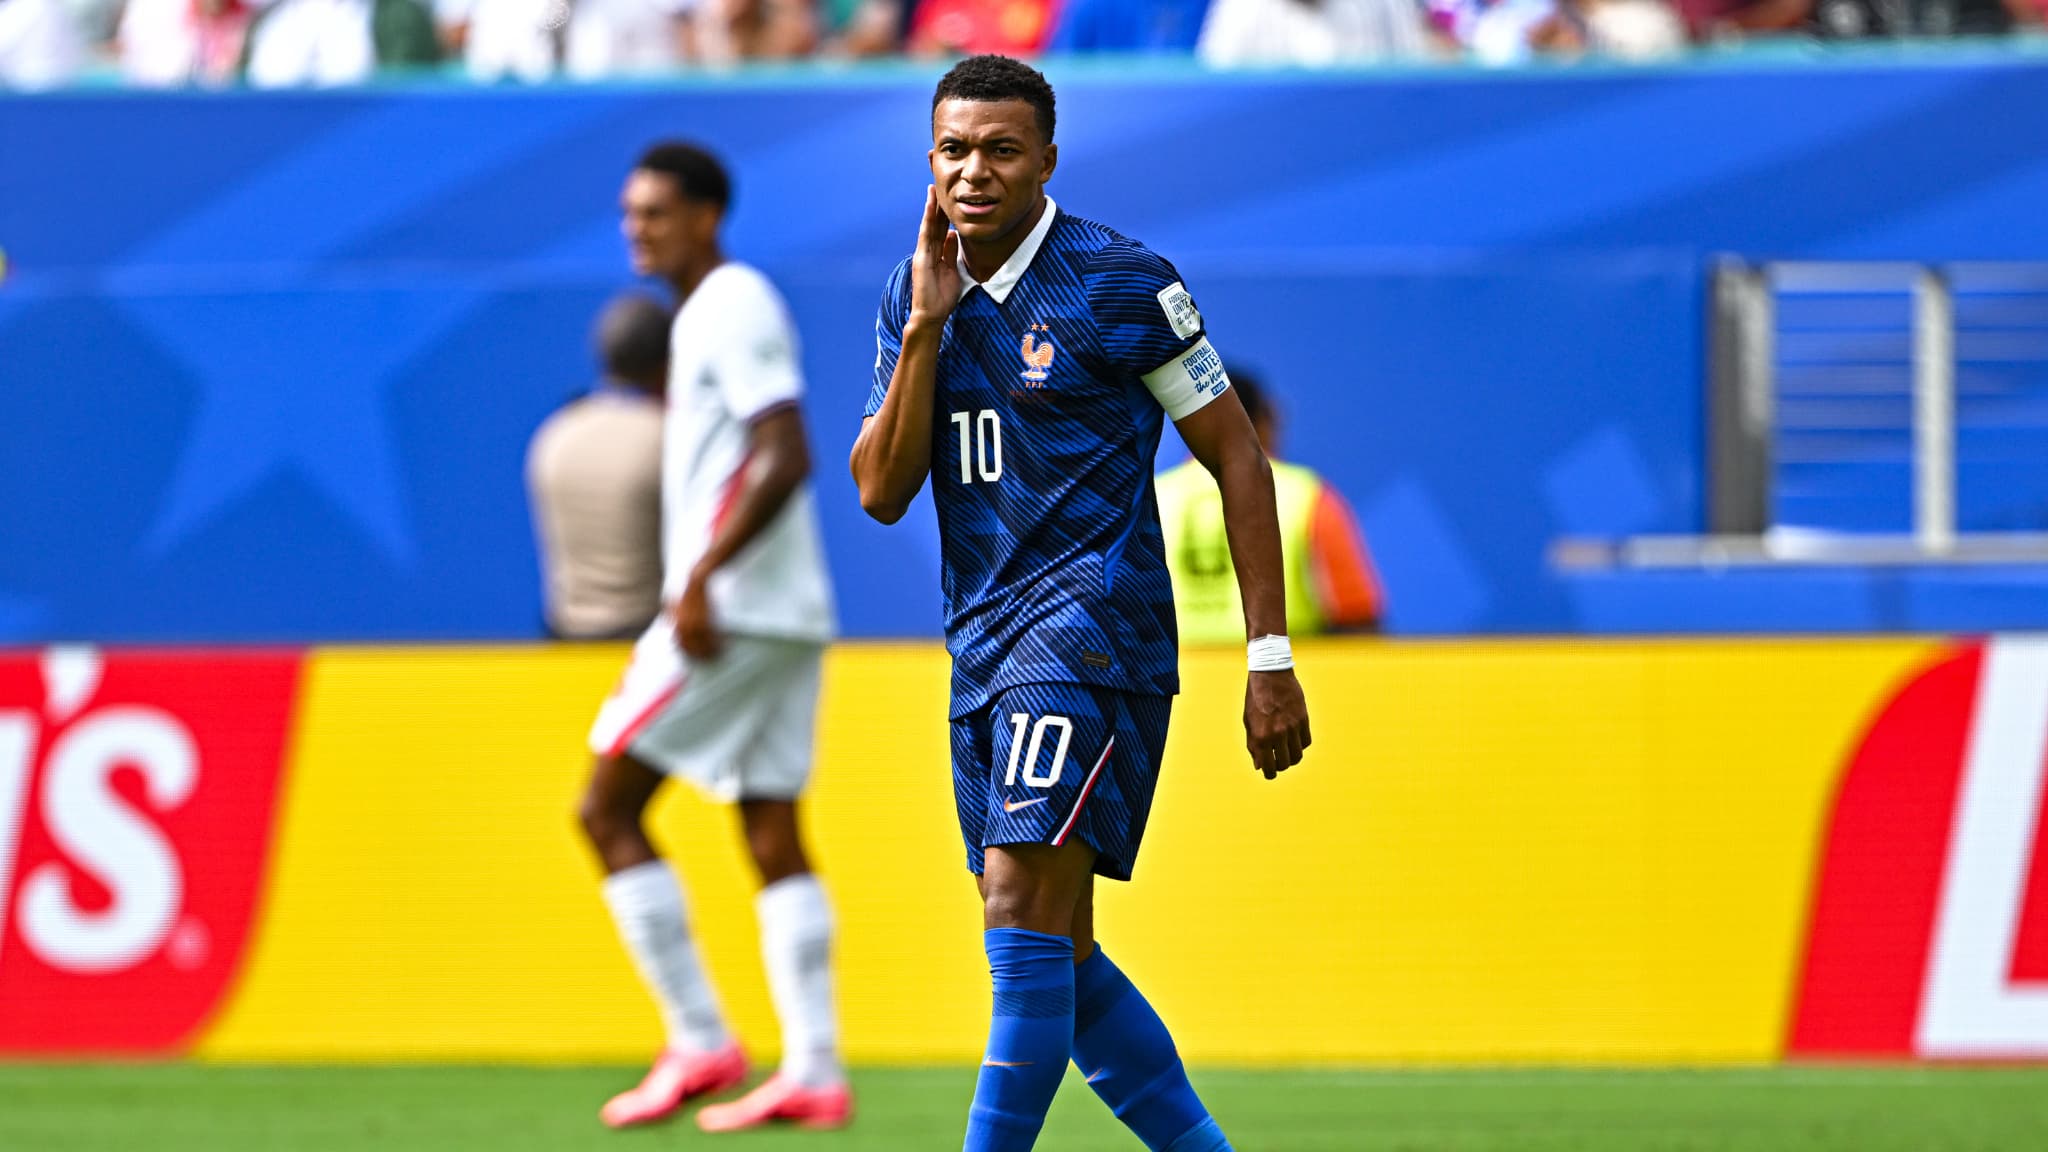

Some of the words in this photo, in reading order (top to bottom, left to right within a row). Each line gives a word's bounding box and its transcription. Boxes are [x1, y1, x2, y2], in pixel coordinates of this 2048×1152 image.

[1172, 297, 1190, 315] UNITE
[1195, 380, 1210, 394] the
[951, 409, 1002, 484] 10
[1005, 713, 1073, 788] 10
